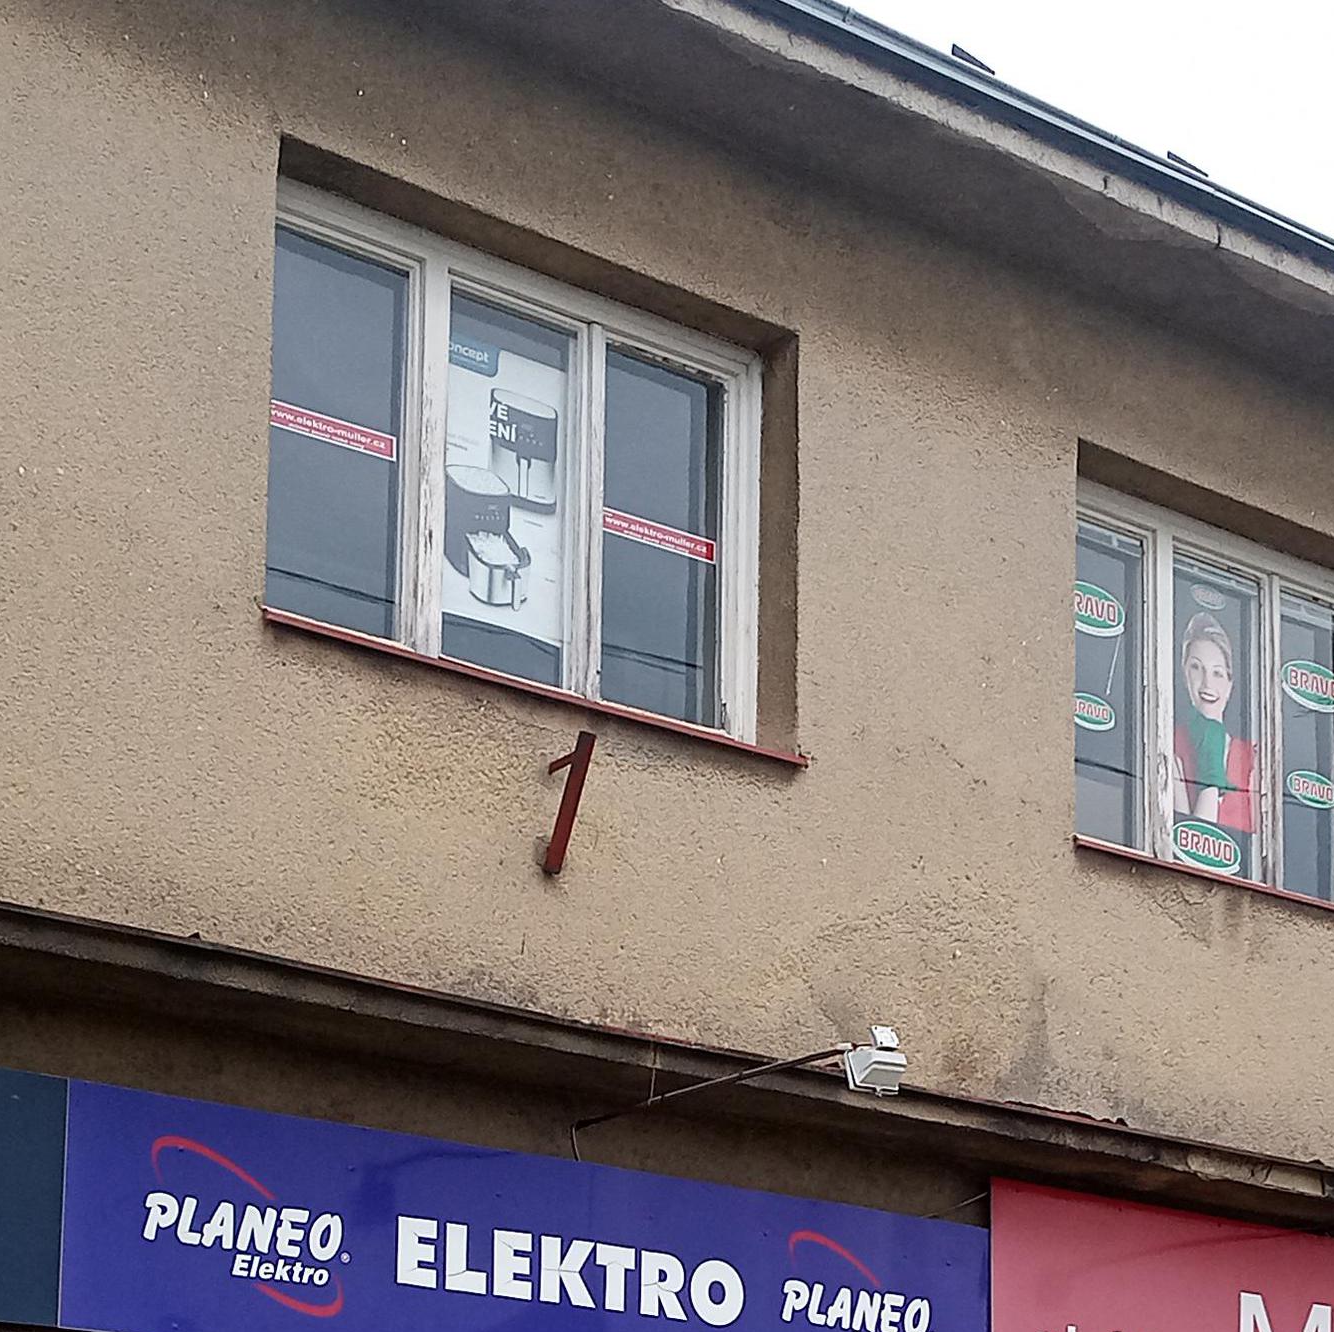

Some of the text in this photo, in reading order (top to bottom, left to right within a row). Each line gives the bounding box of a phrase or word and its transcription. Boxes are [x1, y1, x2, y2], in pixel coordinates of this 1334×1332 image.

[449, 341, 489, 363] oncept
[1074, 590, 1117, 624] RAVO
[1294, 777, 1334, 802] BRAVO
[1178, 829, 1235, 862] BRAVO
[142, 1191, 344, 1264] PLANEO
[231, 1251, 331, 1289] Elektro
[395, 1213, 746, 1328] ELEKTRO
